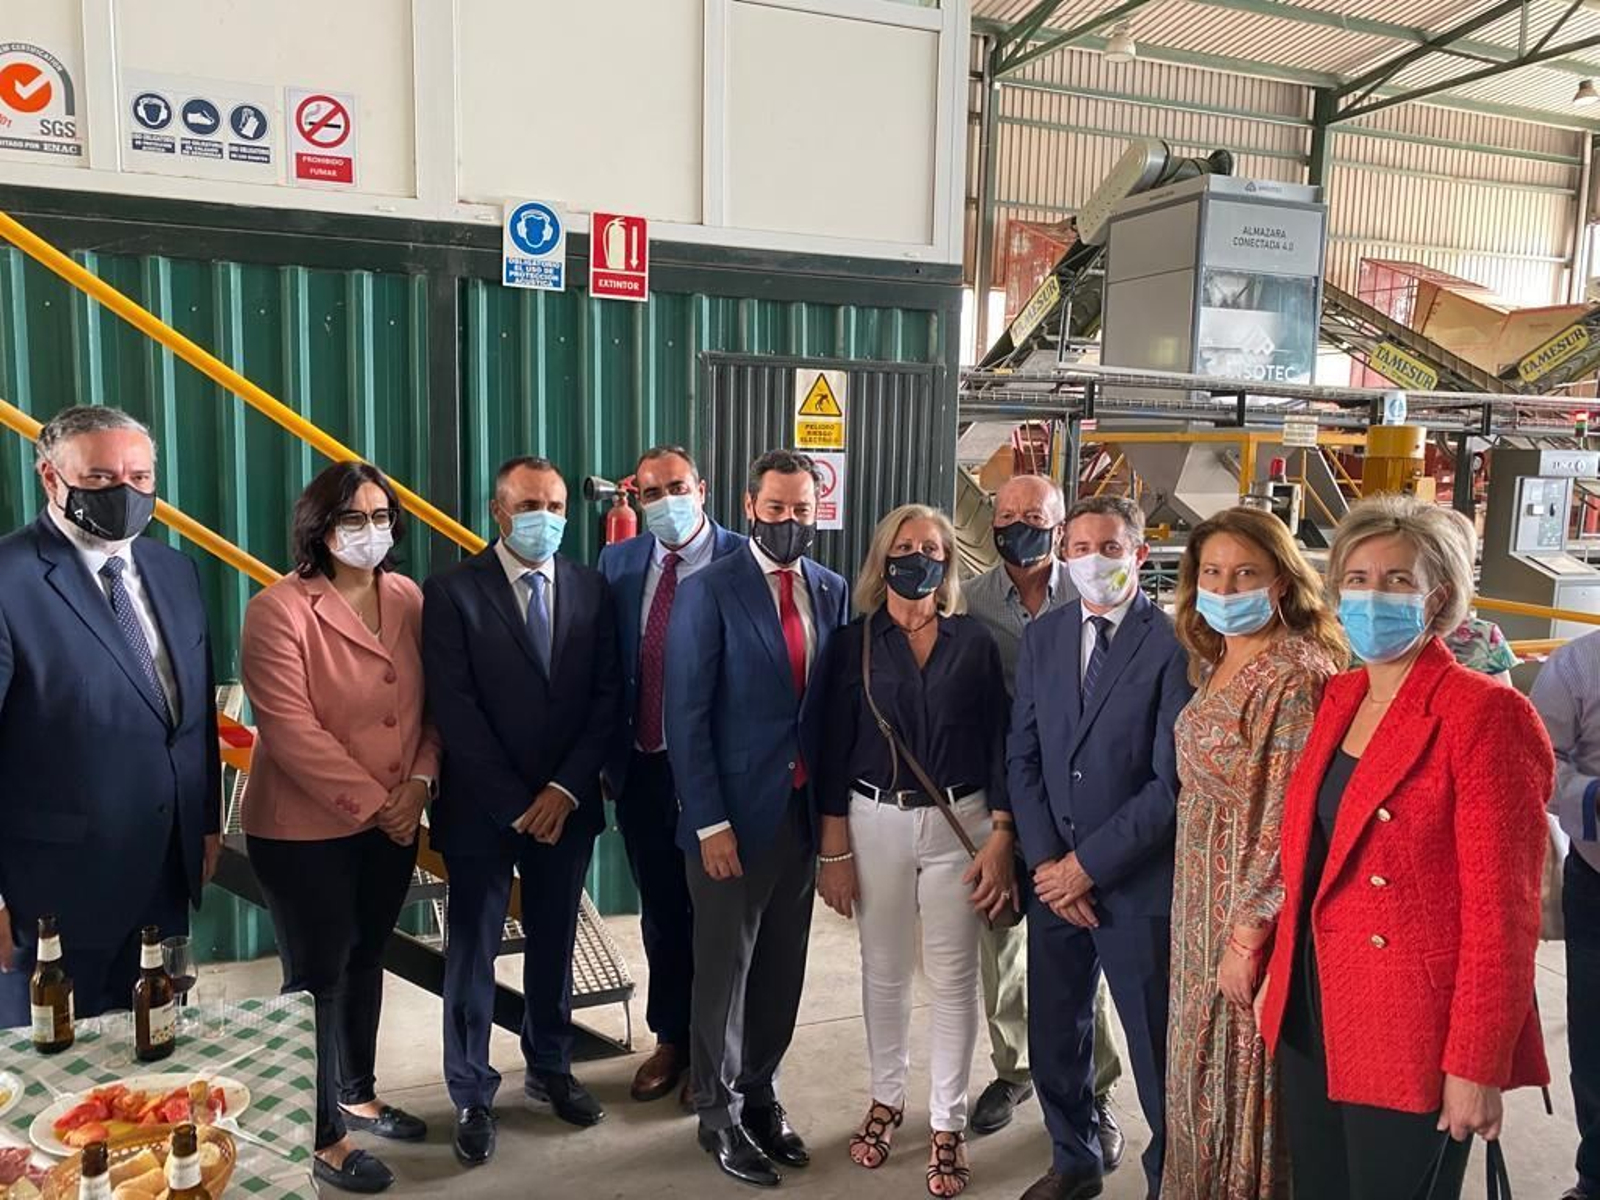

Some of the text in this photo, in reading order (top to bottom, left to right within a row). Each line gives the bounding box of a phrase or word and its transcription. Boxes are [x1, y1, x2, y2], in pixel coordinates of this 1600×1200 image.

[11, 43, 63, 72] CERTIFICATION
[40, 118, 76, 138] SGS
[43, 143, 78, 154] ENAC
[302, 155, 344, 166] PROHIBIDO
[309, 167, 338, 177] FUMAR
[1242, 226, 1287, 239] ALMAZARA
[1232, 236, 1295, 252] CONECTADA 4.0
[598, 278, 640, 291] EXTINTOR
[1522, 328, 1586, 376] TAMESUR
[1375, 345, 1436, 390] TAMESUR
